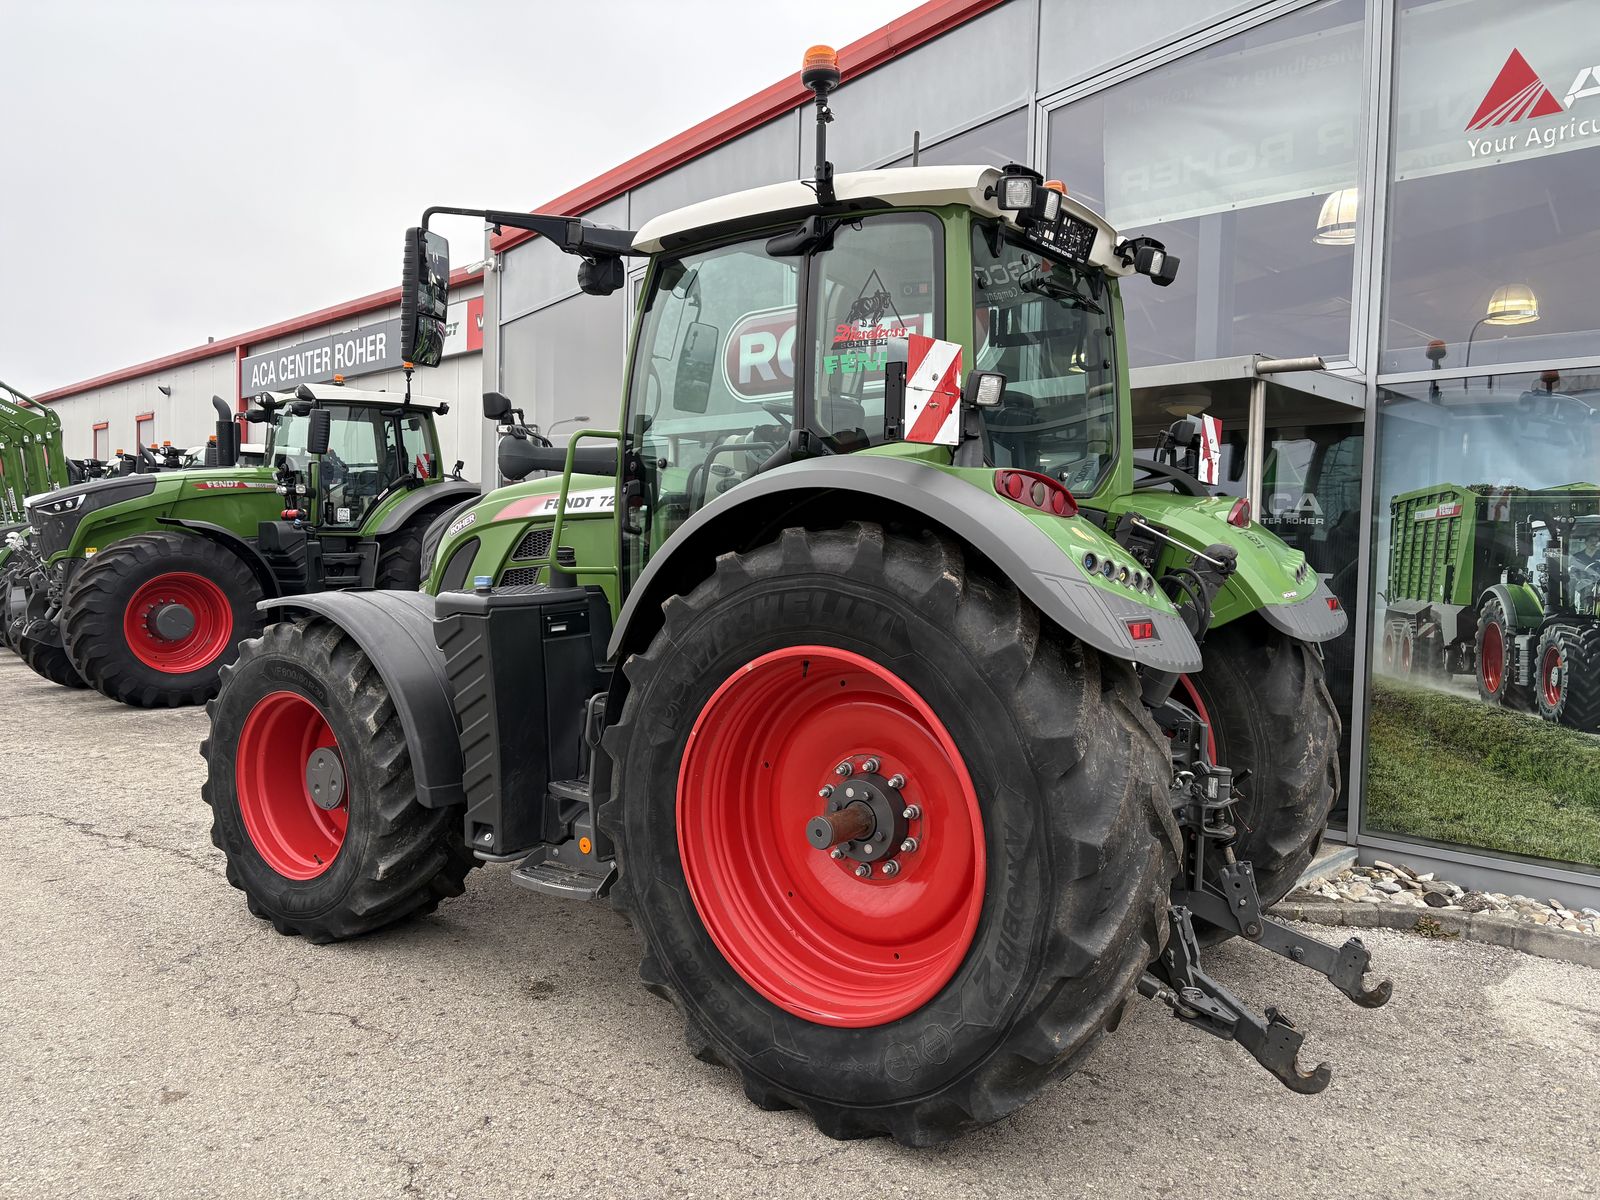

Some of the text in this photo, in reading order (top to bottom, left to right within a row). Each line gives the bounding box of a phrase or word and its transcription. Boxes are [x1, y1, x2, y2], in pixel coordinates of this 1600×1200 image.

[1467, 134, 1518, 158] Your
[833, 323, 908, 343] Dieselross
[251, 333, 387, 388] ACA CENTER ROHER
[823, 351, 888, 376] FEN
[206, 480, 240, 489] FENDT
[1261, 492, 1324, 516] CA
[450, 514, 476, 535] ROHER
[1286, 517, 1324, 525] ROHER
